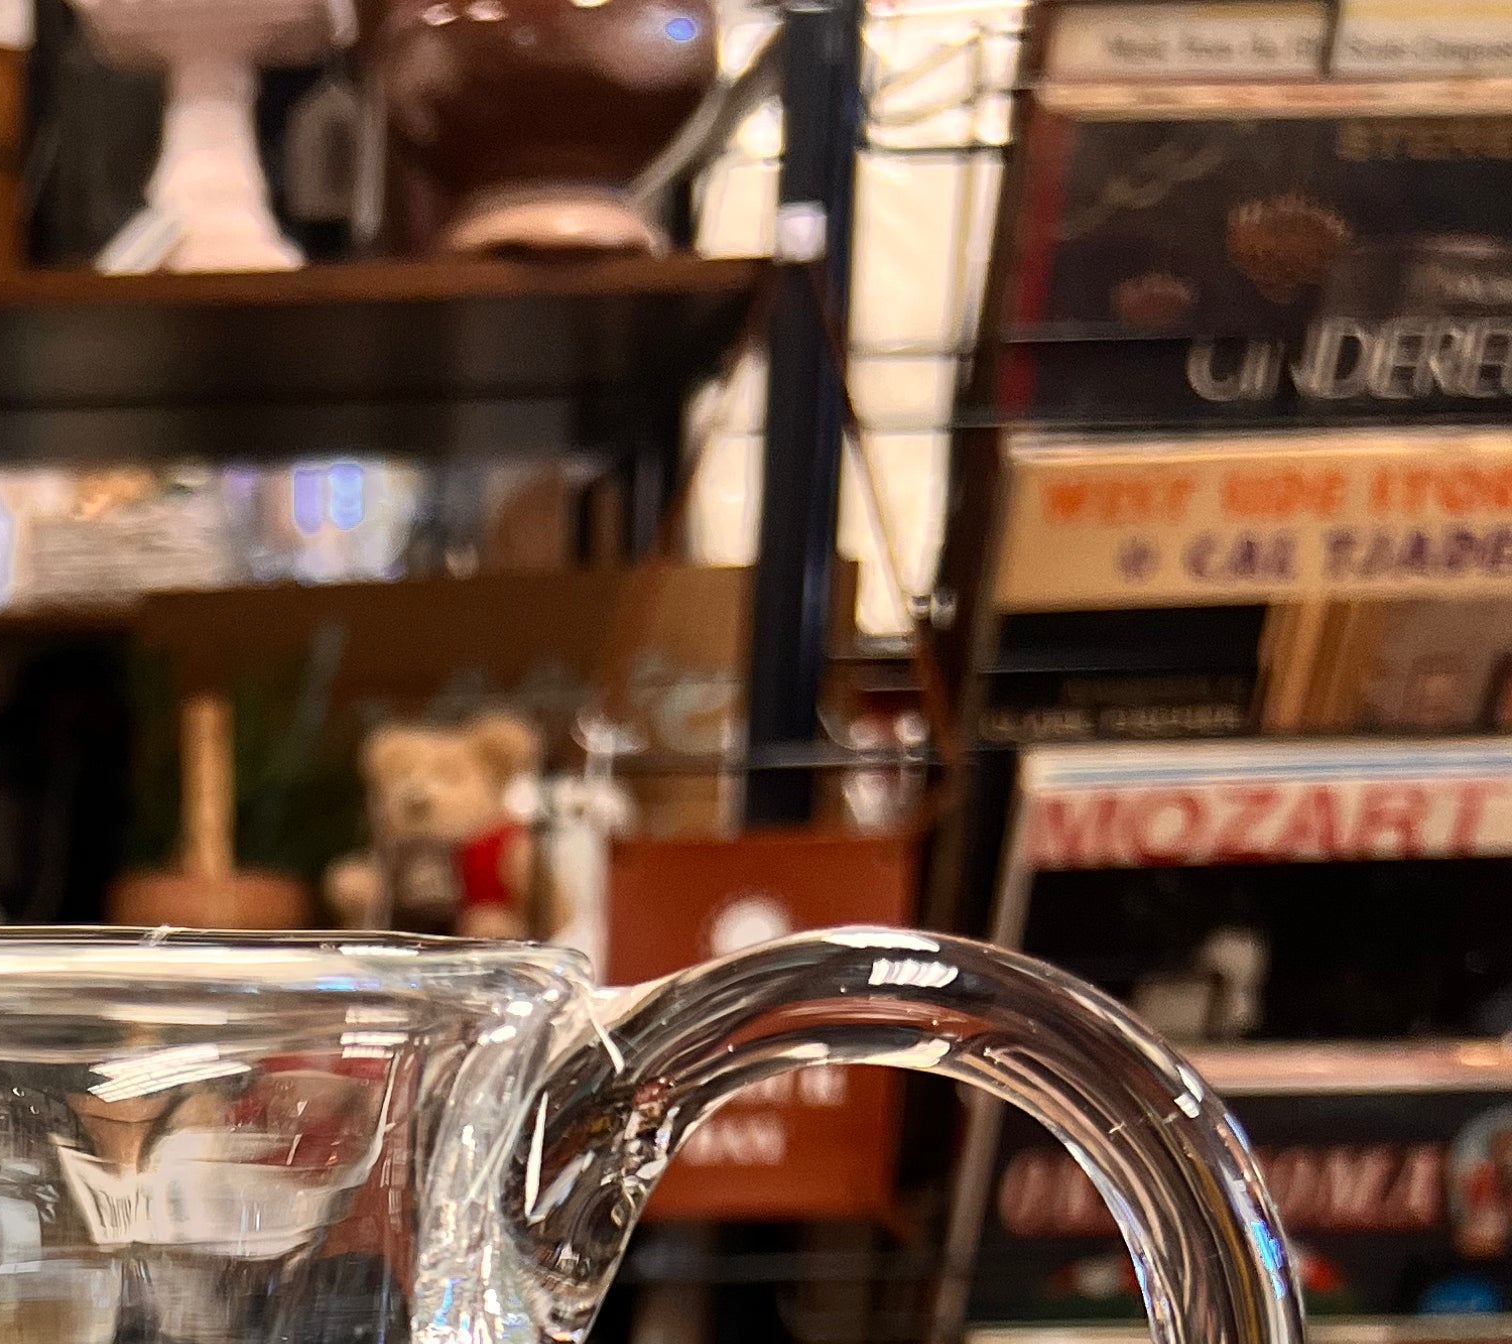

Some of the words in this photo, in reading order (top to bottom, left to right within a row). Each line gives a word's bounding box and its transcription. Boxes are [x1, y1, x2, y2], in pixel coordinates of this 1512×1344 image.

[1184, 314, 1512, 400] CINDERE
[1320, 522, 1512, 580] TJADE
[1024, 782, 1500, 868] MOZART
